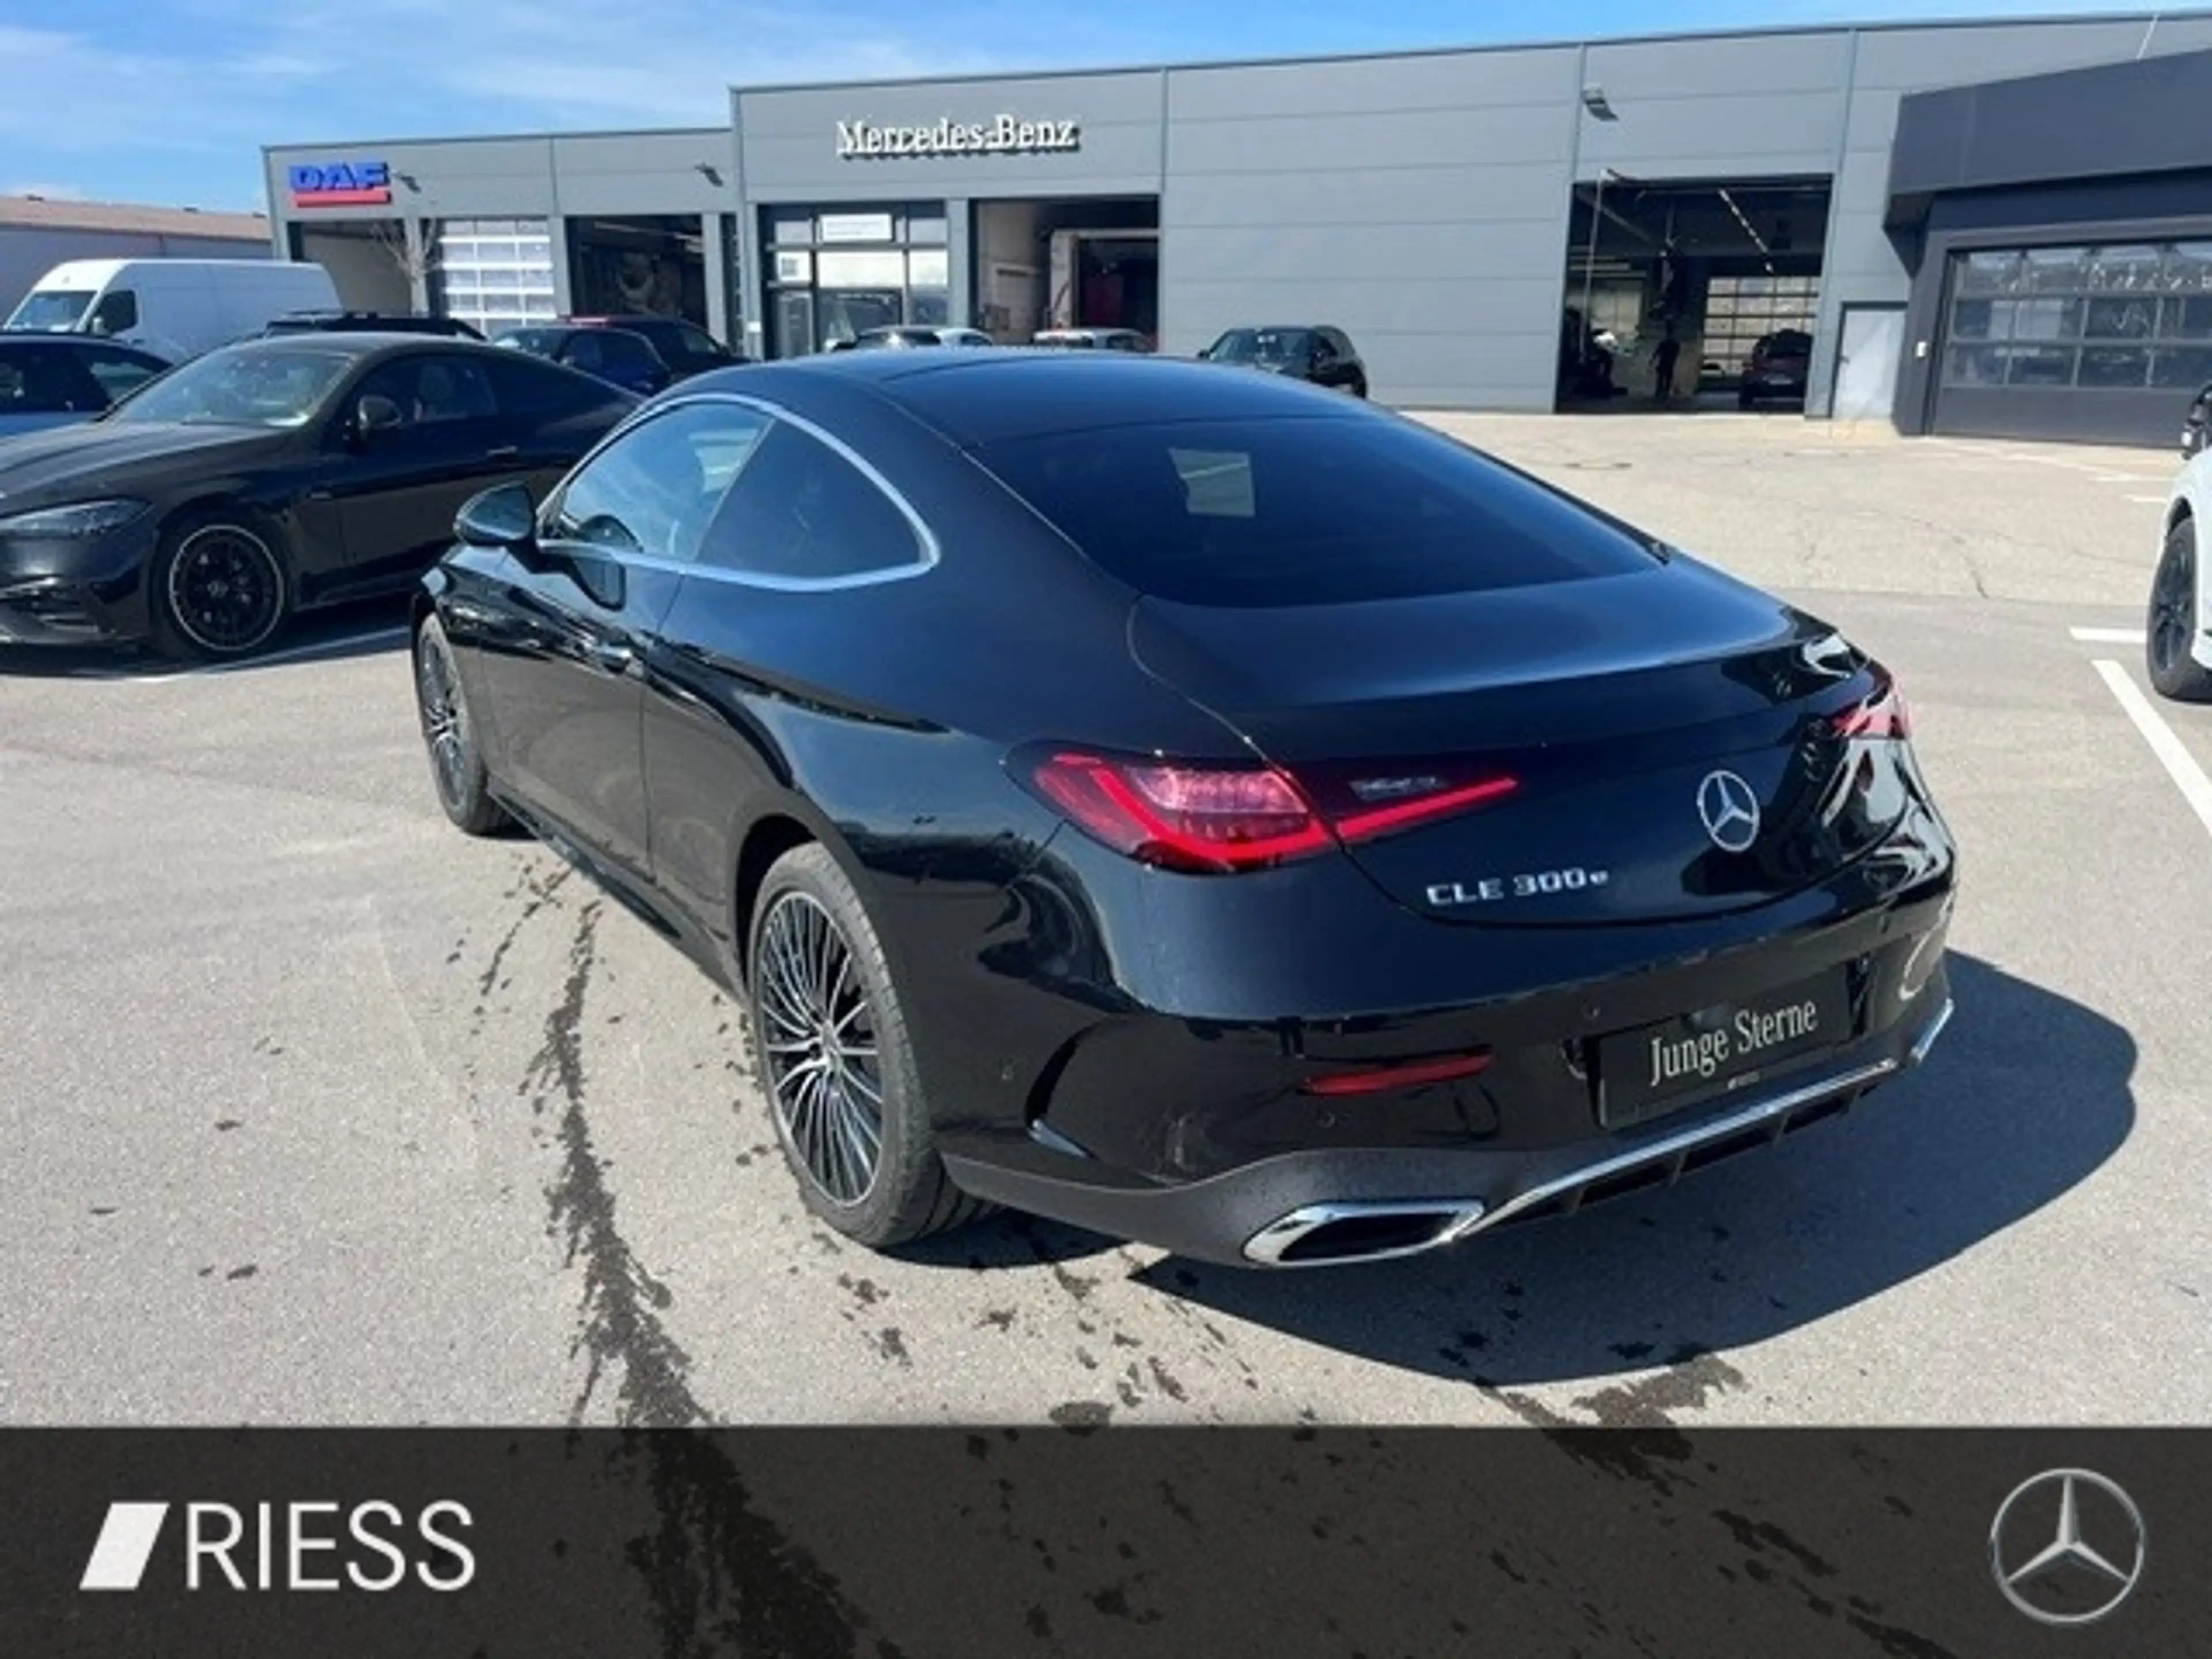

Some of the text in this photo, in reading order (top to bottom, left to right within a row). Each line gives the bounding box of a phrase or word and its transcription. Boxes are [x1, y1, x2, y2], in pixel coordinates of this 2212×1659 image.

[836, 115, 1077, 156] Mercedes-Benz
[290, 162, 388, 190] DAF
[1426, 878, 1505, 906] CLE
[1650, 1000, 1819, 1087] Junge Sterne
